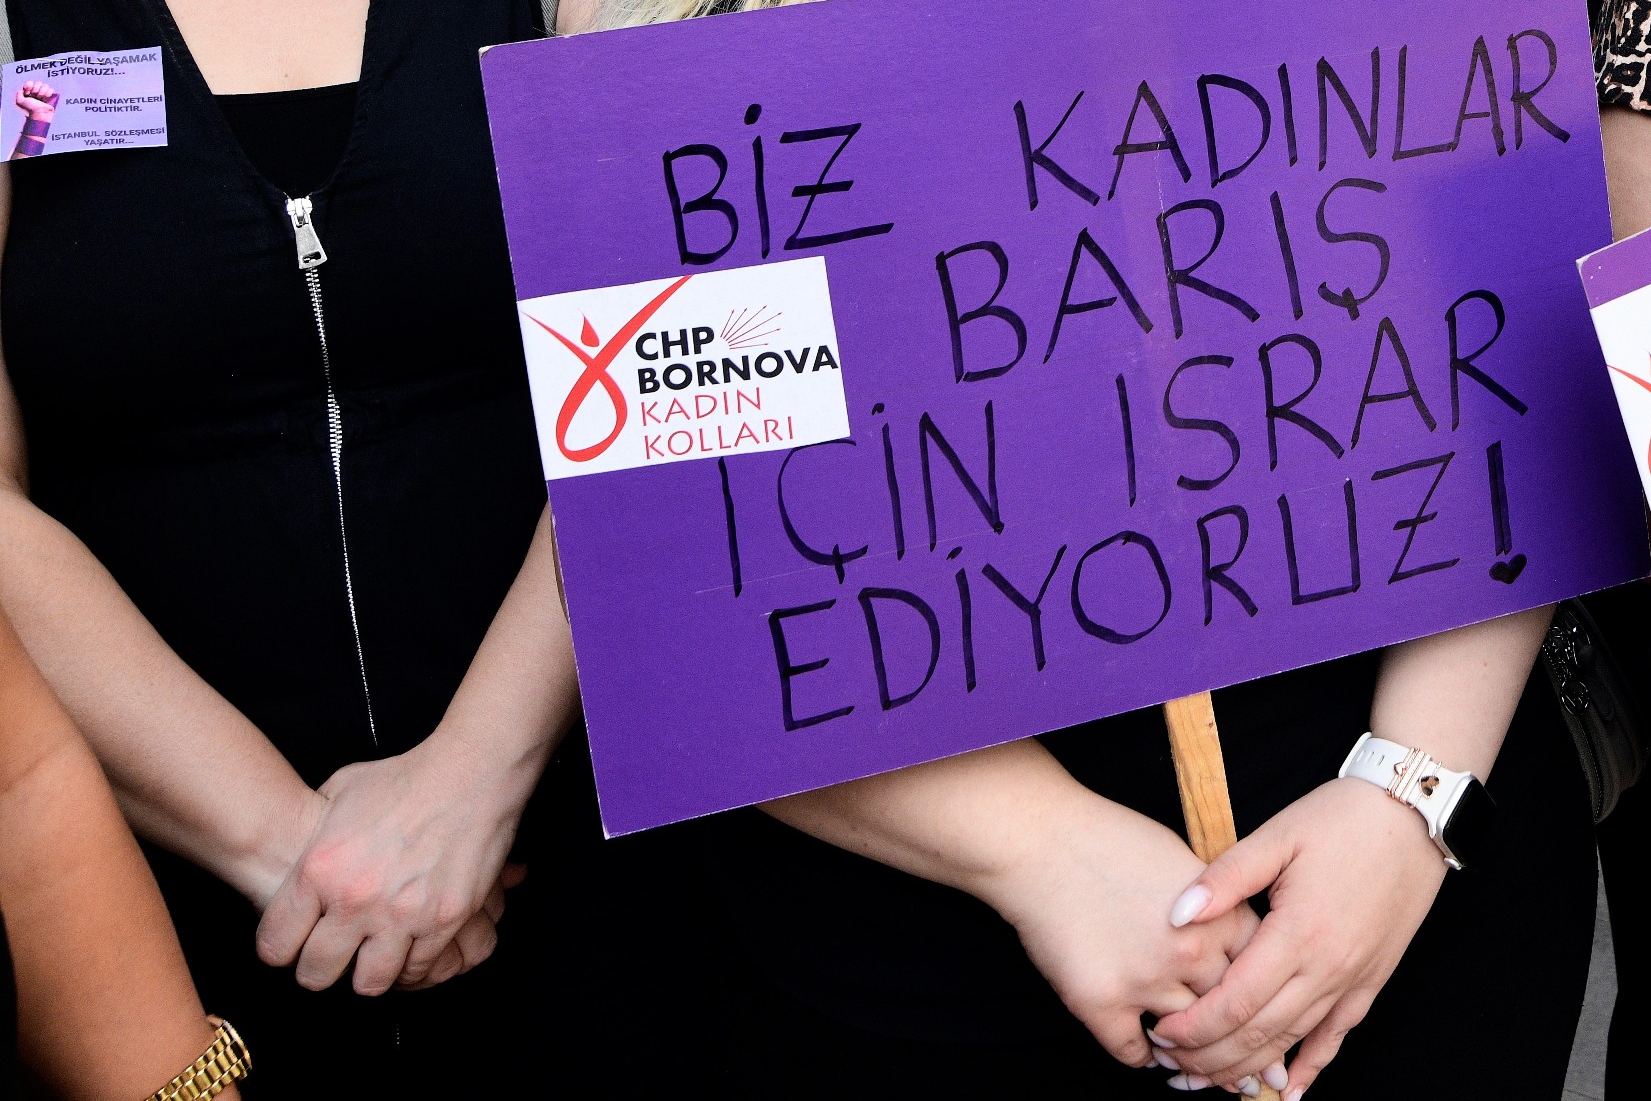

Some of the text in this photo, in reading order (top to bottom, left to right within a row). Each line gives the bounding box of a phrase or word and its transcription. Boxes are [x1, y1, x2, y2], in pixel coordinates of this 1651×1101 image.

[15, 60, 57, 74] ÖLMEK
[97, 52, 157, 67] YAŞAMAK
[65, 95, 163, 105] KADIN CİNAYETLERİ
[84, 105, 142, 113] POLİTİKTİR.
[51, 127, 165, 141] İSTANBUL SÖZLEŞMESİ
[663, 28, 1569, 266] BİZ KADINLAR
[937, 177, 1393, 385] BARIŞ
[635, 326, 715, 361] CHP
[637, 345, 838, 394] BORNOVA
[640, 387, 761, 427] KADIN
[1117, 289, 1528, 506] ISRAR
[643, 416, 794, 460] KOLLARI
